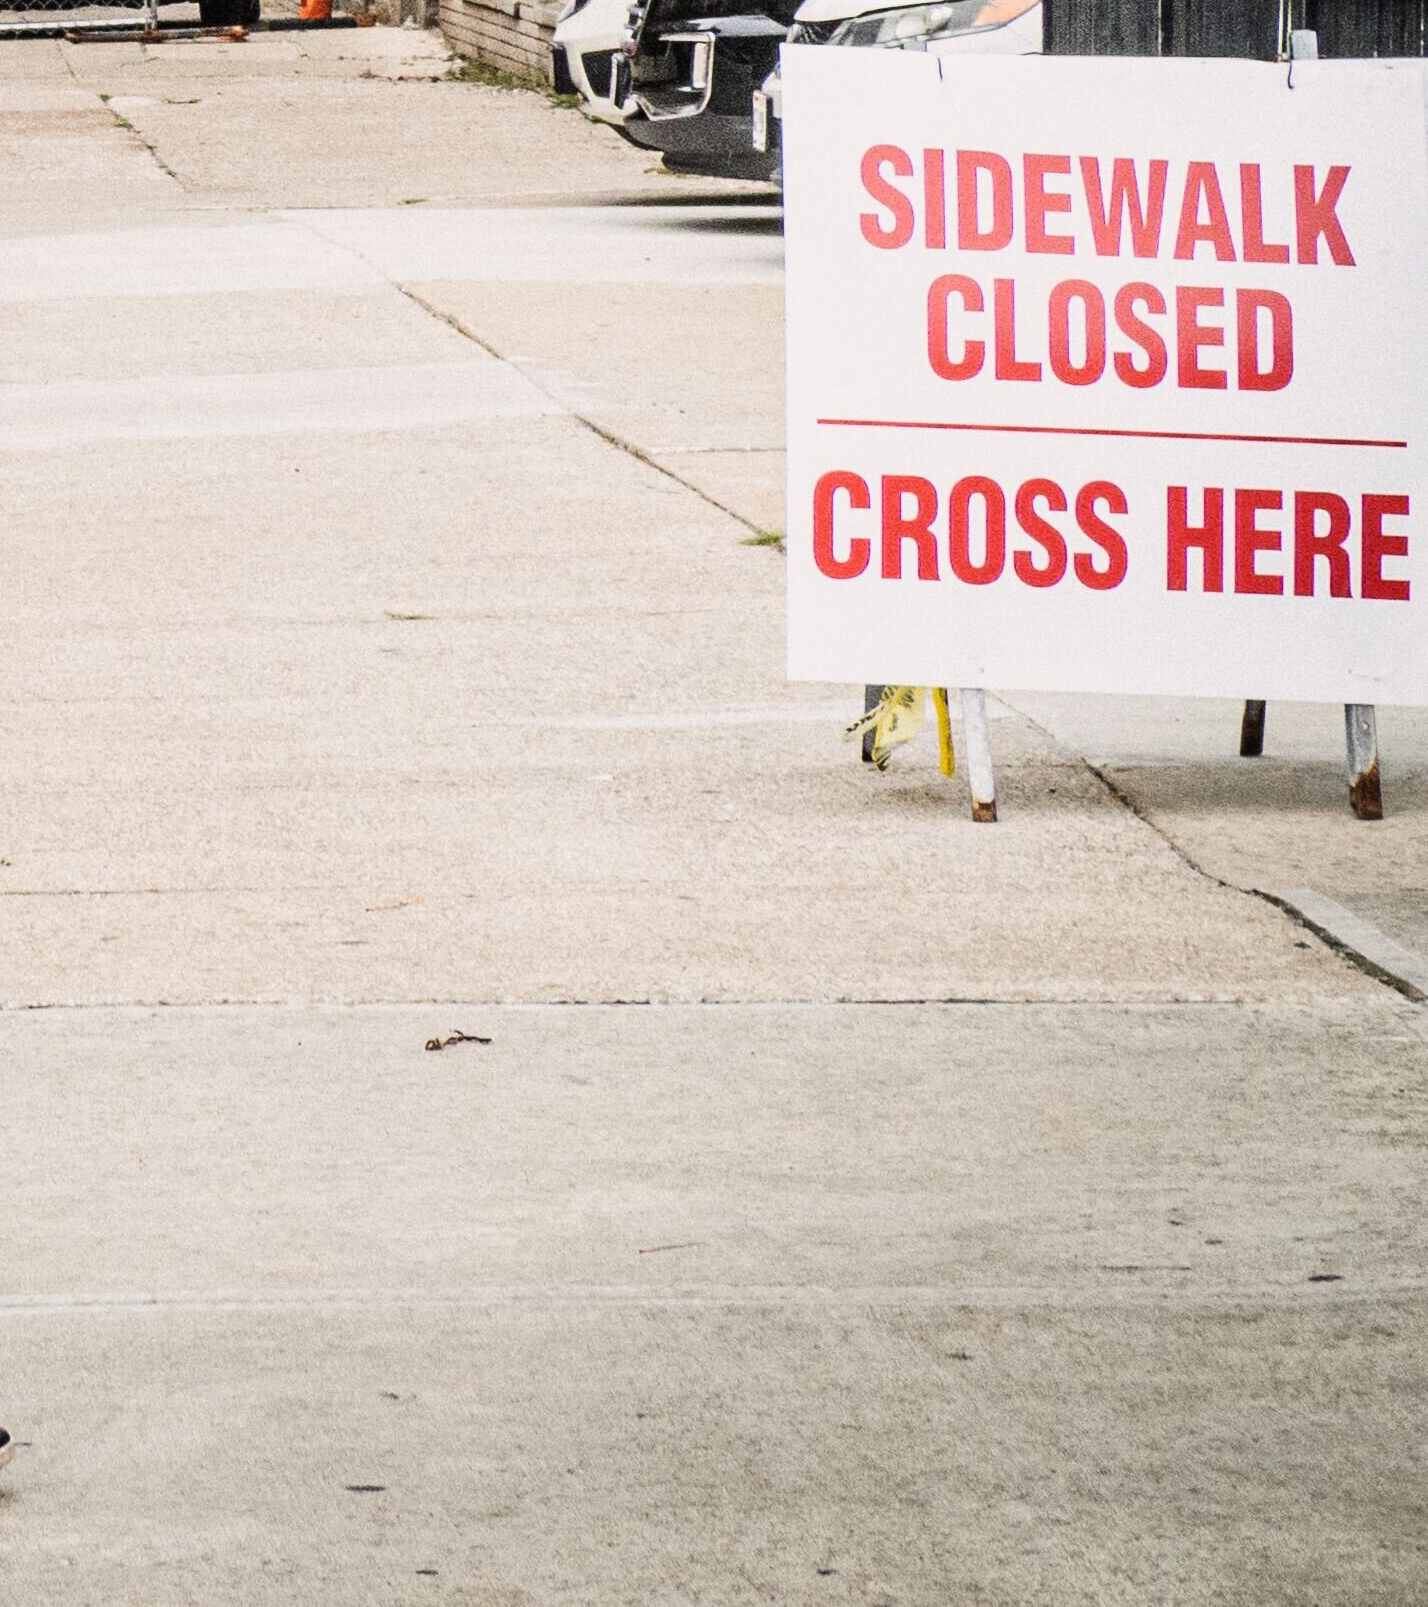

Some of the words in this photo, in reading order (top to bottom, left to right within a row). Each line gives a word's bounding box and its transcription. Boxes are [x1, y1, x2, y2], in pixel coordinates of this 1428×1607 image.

[858, 142, 1357, 268] SIDEWALK
[926, 273, 1295, 393] CLOSED
[812, 469, 1130, 591] CROSS
[1165, 485, 1412, 602] HERE
